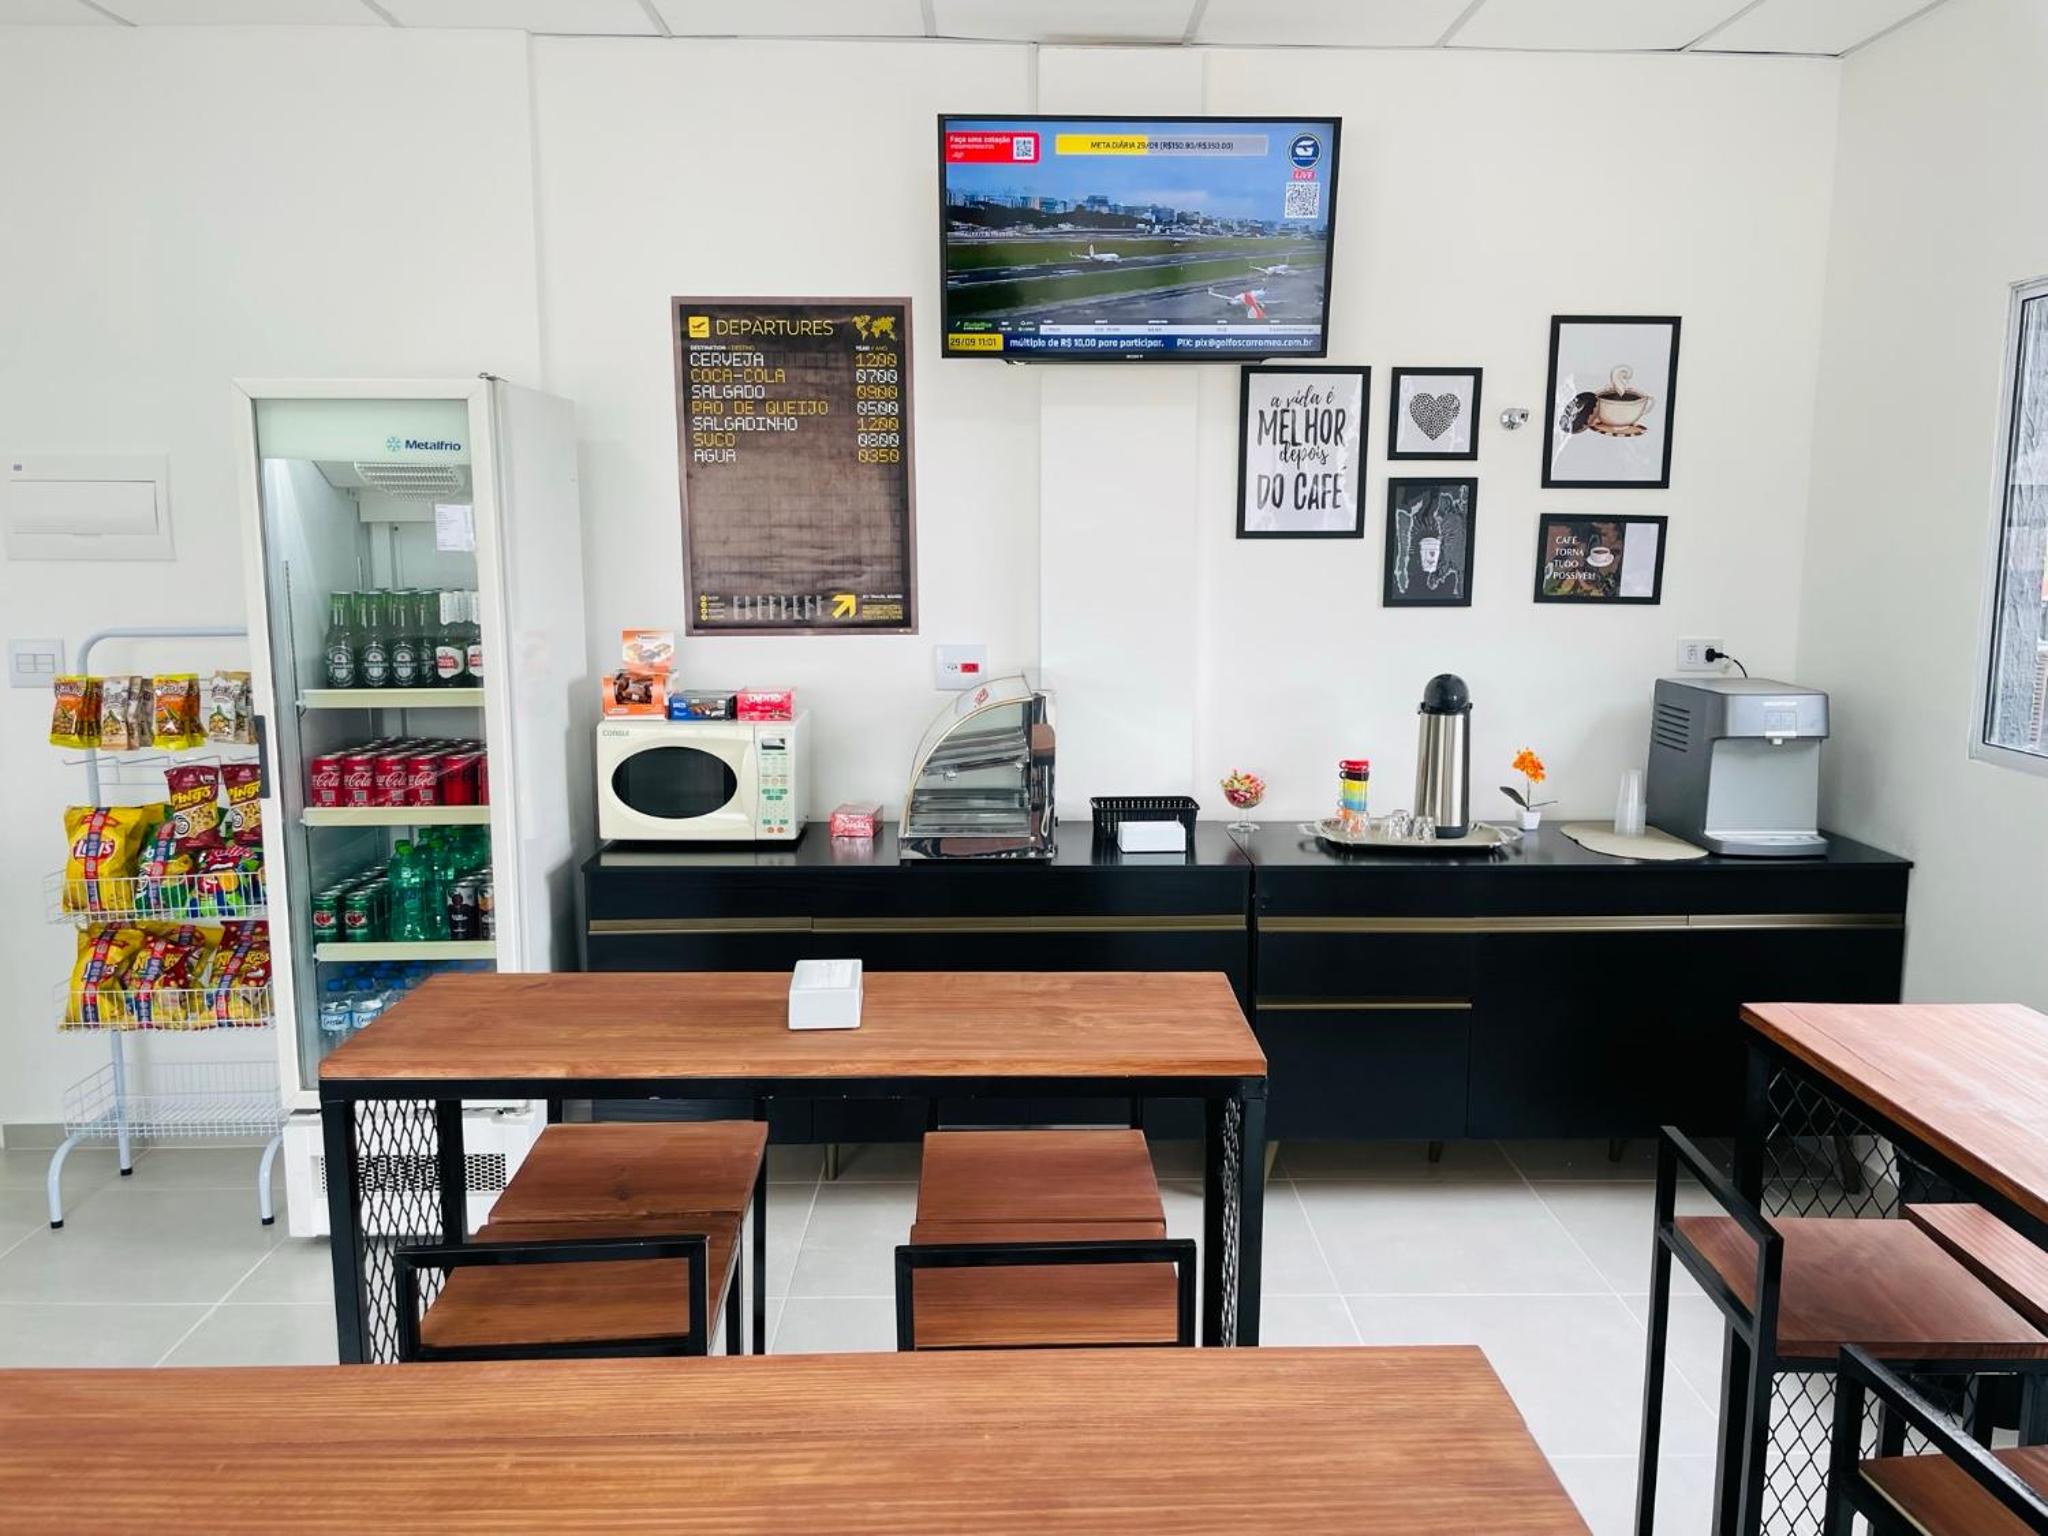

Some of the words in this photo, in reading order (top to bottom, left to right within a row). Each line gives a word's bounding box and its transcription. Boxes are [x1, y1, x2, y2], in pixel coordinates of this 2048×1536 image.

[716, 319, 834, 336] DEPARTURES
[950, 337, 975, 347] 29/09
[978, 337, 997, 346] 11:01
[1010, 337, 1046, 348] múltiplo
[1048, 338, 1059, 347] de
[1061, 338, 1072, 348] R$
[1098, 340, 1118, 348] para
[690, 352, 764, 367] CERVEJA
[855, 354, 897, 367] 1200
[690, 368, 786, 383] COCA-COLA
[856, 369, 898, 383] 0700
[691, 385, 766, 399] SALGADO
[856, 385, 898, 399] 0900
[1270, 395, 1281, 407] a
[1286, 385, 1321, 408] vida
[1326, 386, 1335, 405] é
[734, 401, 755, 415] DE
[766, 401, 829, 415] QUEIJO
[857, 401, 898, 415] 0500
[692, 417, 798, 431] SALGADINHO
[857, 418, 899, 431] 1200
[1257, 407, 1347, 447] MELHOR
[404, 439, 462, 451] Metalfrio
[693, 433, 736, 447] SUCO
[858, 433, 900, 447] 0800
[858, 449, 900, 463] 0350
[1280, 443, 1329, 470] depois
[1257, 473, 1284, 510] DO
[1294, 465, 1347, 511] CAFÉ
[1555, 548, 1584, 557] TORNA
[1553, 559, 1579, 568] TUDO
